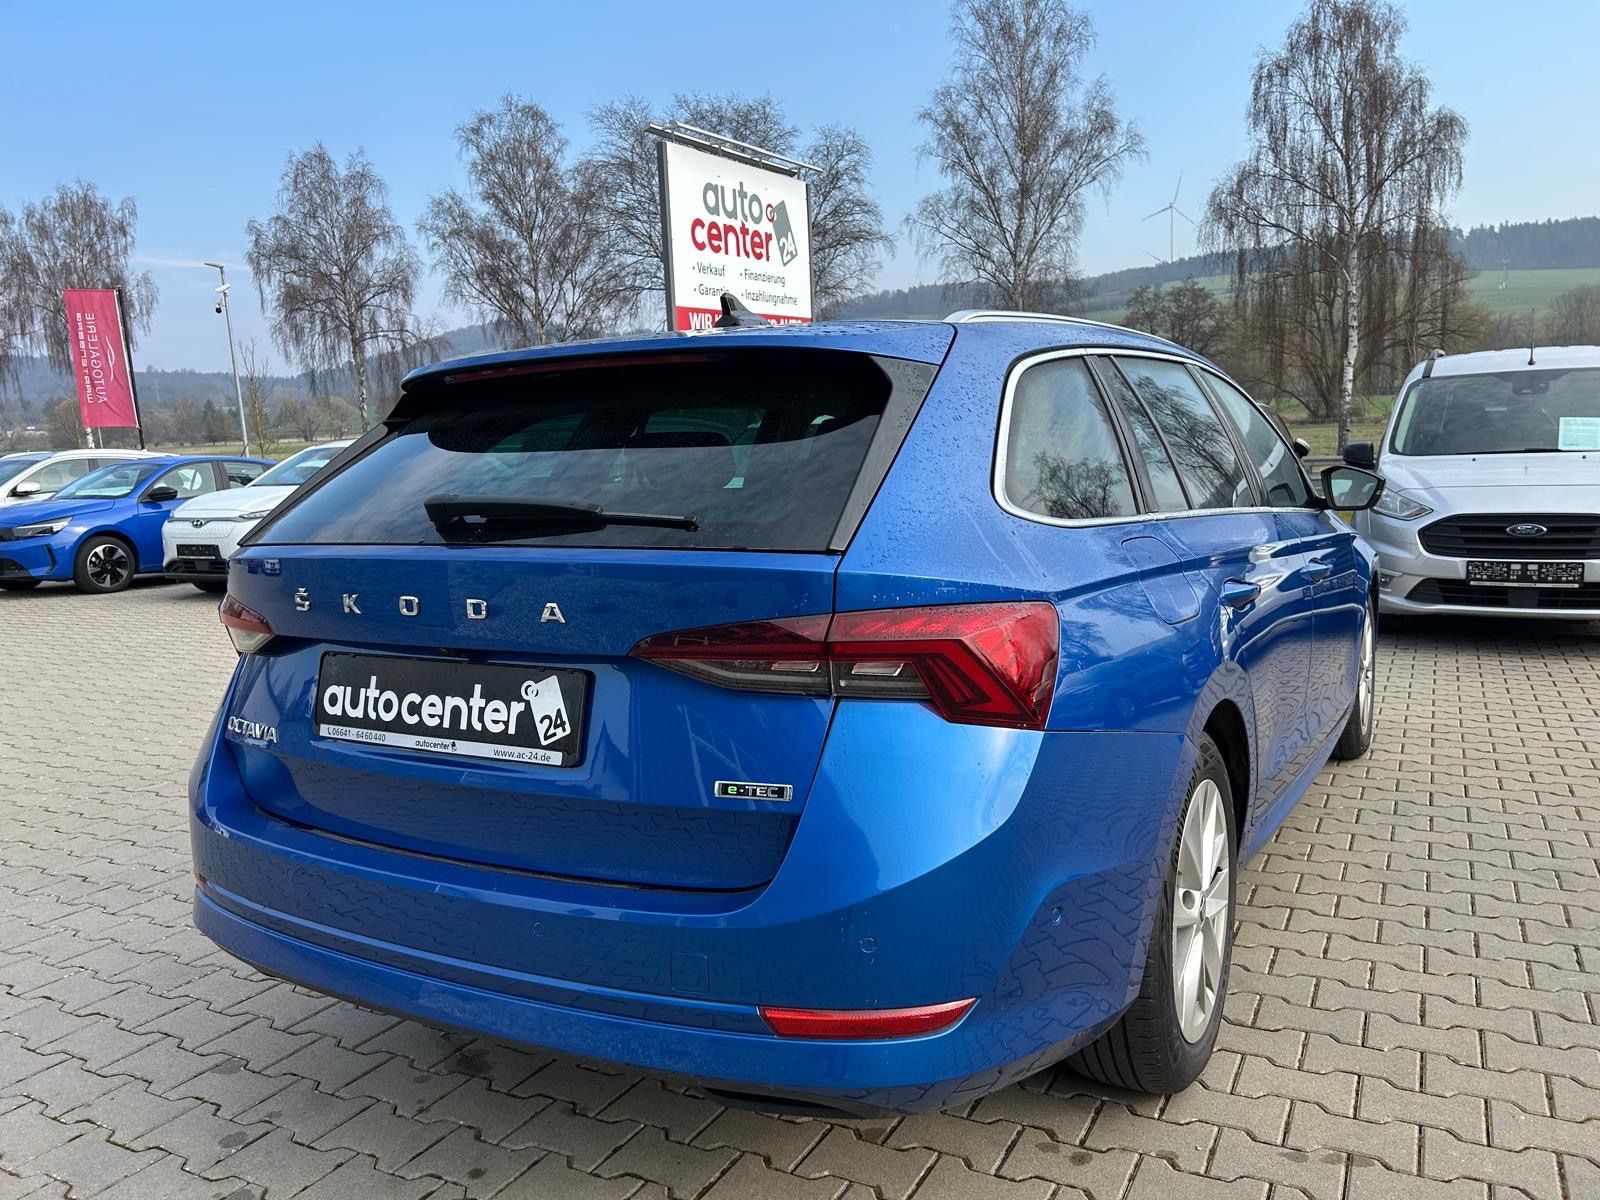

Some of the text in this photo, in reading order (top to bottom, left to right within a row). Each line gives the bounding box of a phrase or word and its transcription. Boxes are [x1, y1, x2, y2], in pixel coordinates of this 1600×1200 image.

[702, 181, 763, 225] auto
[690, 217, 773, 262] center
[779, 232, 797, 263] 24
[697, 262, 725, 277] Verkauf
[744, 268, 786, 287] Finanzierung
[745, 289, 798, 306] Inzahlungnahme
[688, 312, 712, 330] WIR
[228, 716, 277, 743] OCTAVIA
[538, 708, 567, 741] 24
[415, 740, 450, 750] autocenter
[493, 749, 551, 762] www.ac-24.de
